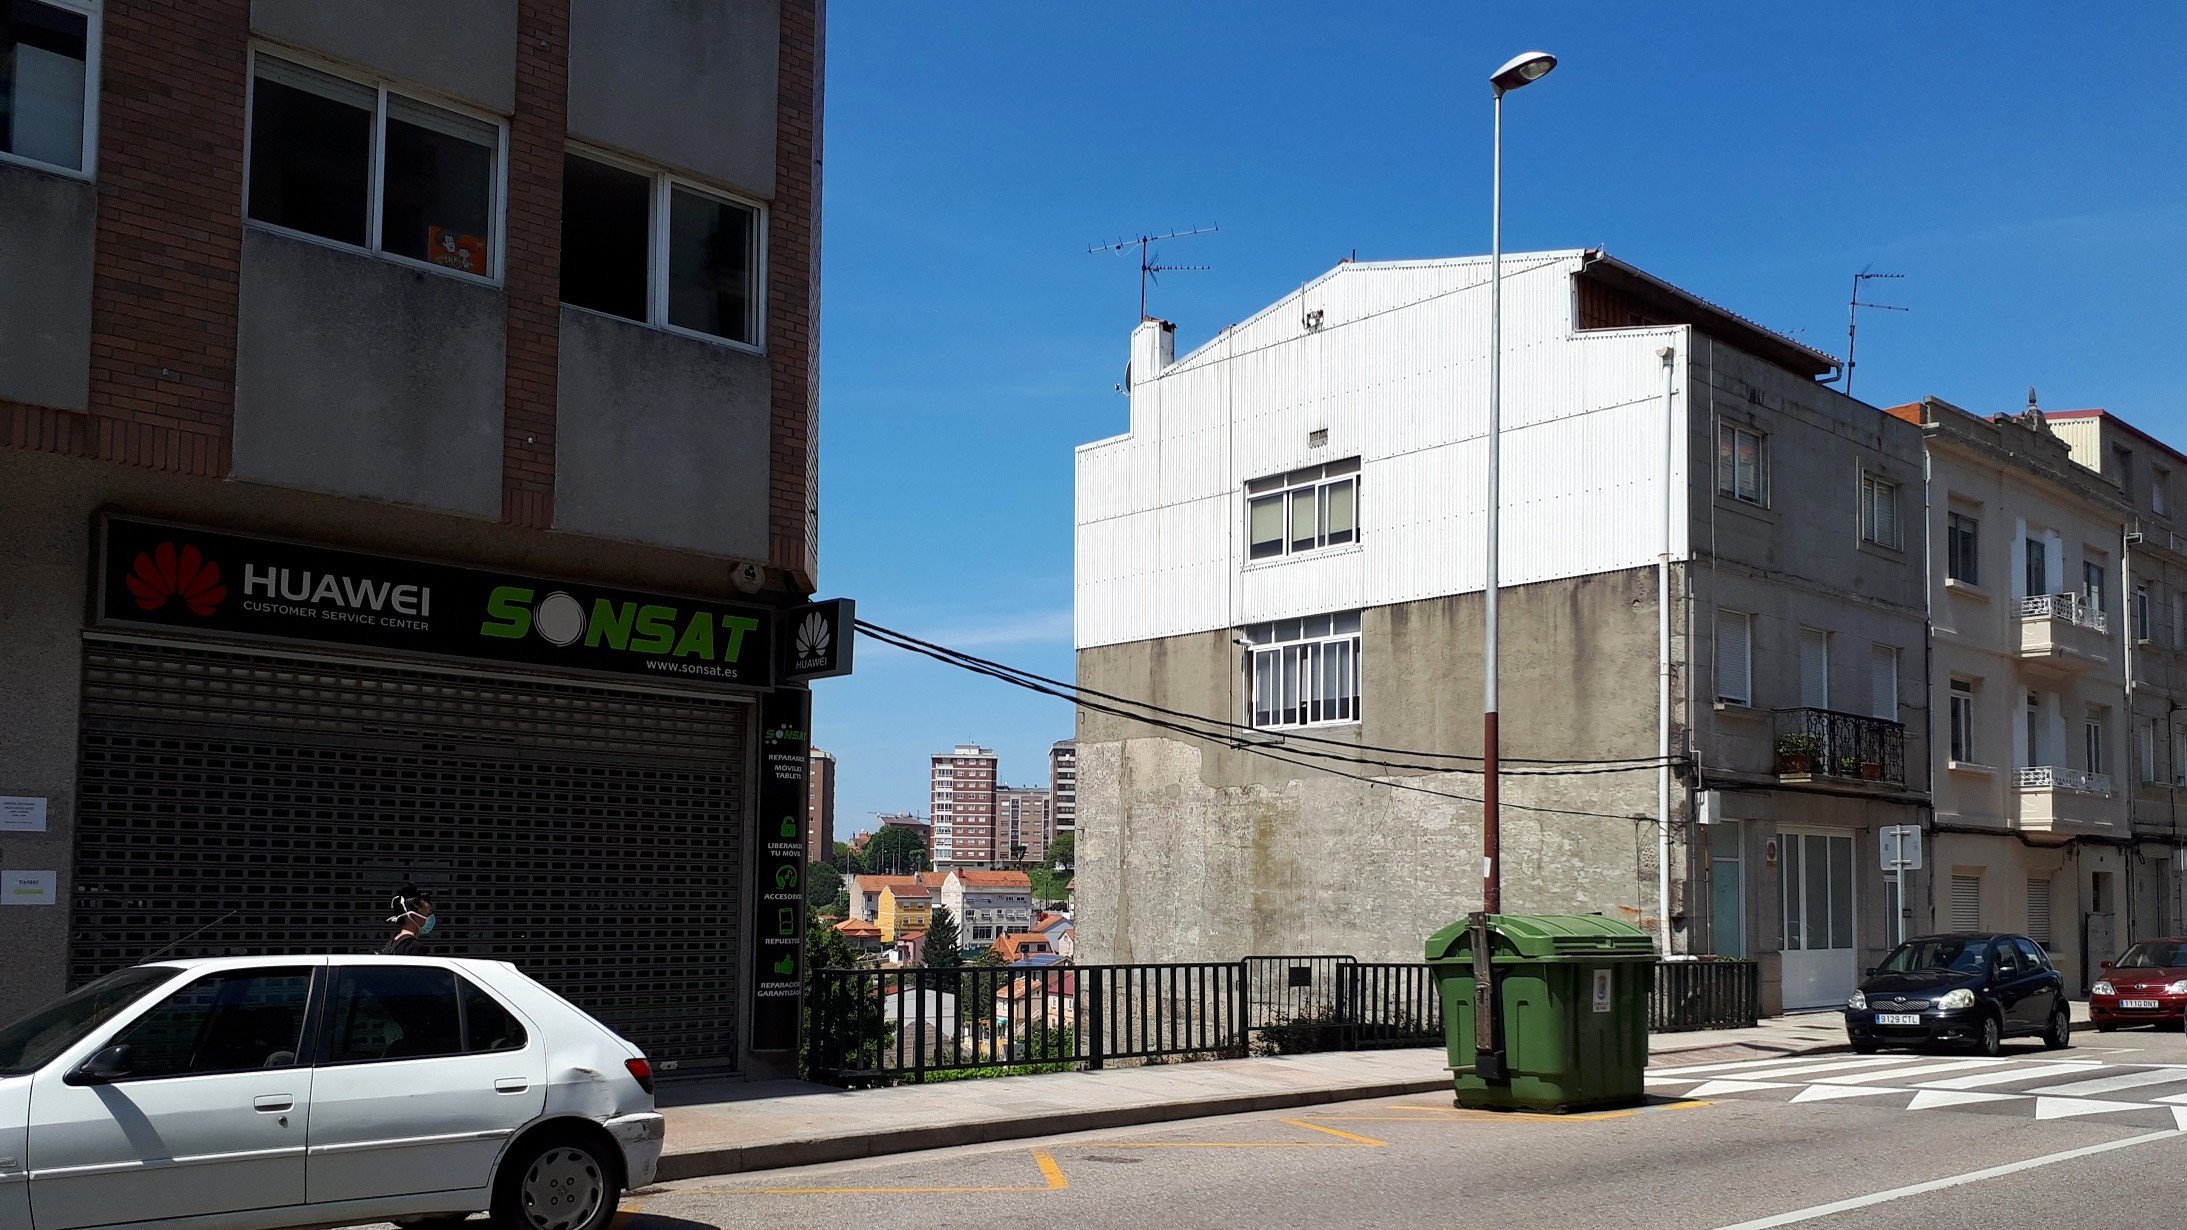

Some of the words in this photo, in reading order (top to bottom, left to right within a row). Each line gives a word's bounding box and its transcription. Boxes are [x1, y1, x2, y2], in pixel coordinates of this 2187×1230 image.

[243, 563, 431, 617] HUAWEI
[243, 601, 317, 618] CUSTOMER
[322, 609, 376, 625] SERVICE
[380, 616, 429, 631] CENTER
[479, 585, 759, 663] SONSAT
[646, 659, 738, 678] www.sonsat.es
[796, 656, 827, 670] HUAWEI
[776, 772, 801, 780] TABLETS
[1881, 1015, 1900, 1023] 9129
